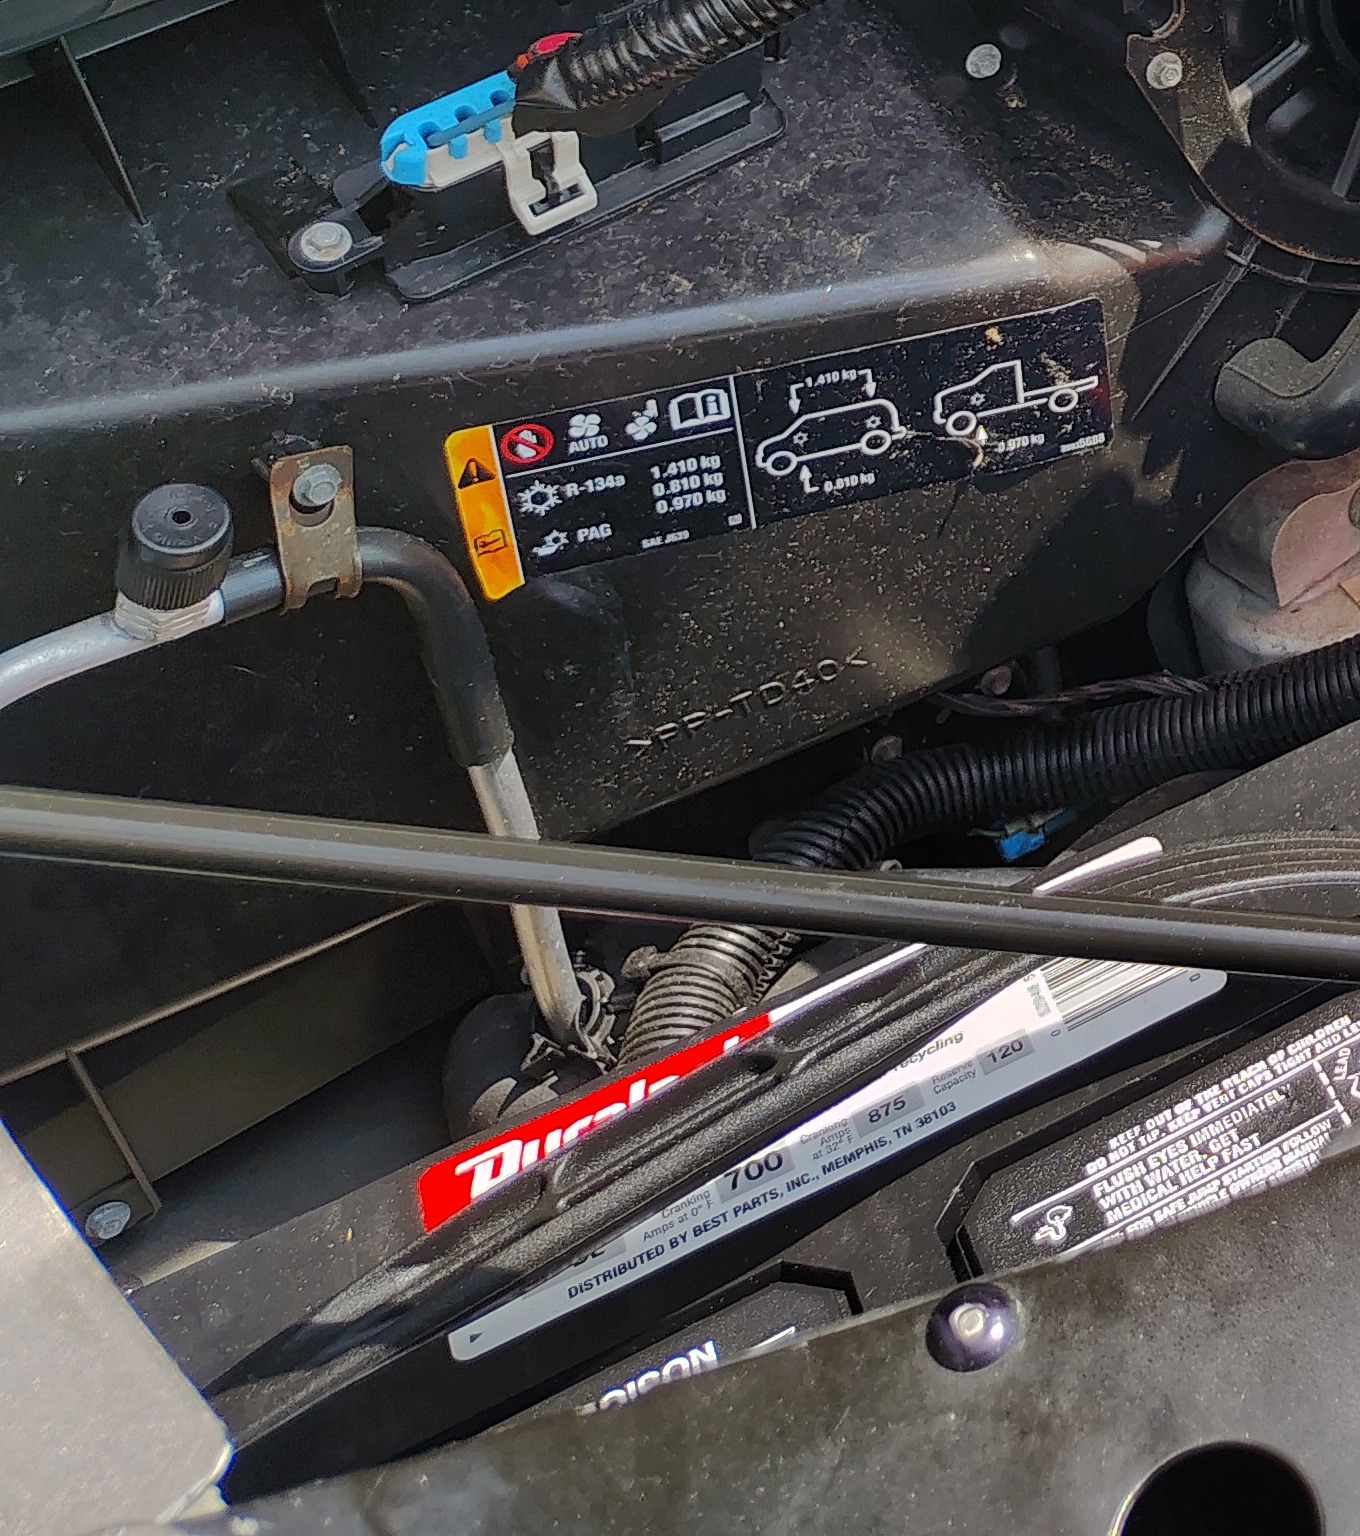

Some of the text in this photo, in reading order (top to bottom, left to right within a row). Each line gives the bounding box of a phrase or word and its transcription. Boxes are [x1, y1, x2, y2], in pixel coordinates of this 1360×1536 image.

[804, 366, 858, 387] 1.410 kg
[568, 435, 609, 455] AUTO
[650, 455, 721, 480] 1.410 kg
[564, 474, 626, 498] R-134a
[652, 471, 724, 497] 0.810 kg
[655, 488, 727, 514] 0.970 kg
[576, 522, 613, 543] PAG
[986, 1039, 1024, 1065] 120
[931, 1061, 974, 1085] Reserve
[933, 1068, 978, 1096] Capacity
[1109, 1124, 1141, 1149] KEEP
[1146, 1109, 1173, 1130] OUT
[1194, 1086, 1221, 1106] THE
[1221, 1061, 1266, 1092] REACH
[1267, 1051, 1287, 1067] OF
[1287, 1015, 1352, 1057] CHILDREN
[867, 1096, 907, 1124] 875
[1085, 1156, 1107, 1178] DO
[1108, 1139, 1140, 1163] NOT
[1141, 1128, 1166, 1147] TIP.
[1168, 1110, 1201, 1133] KEEP
[1202, 1093, 1239, 1118] VENT
[1239, 1072, 1274, 1097] CAPS
[1274, 1051, 1315, 1079] TIGHT
[1315, 1036, 1342, 1056] AND
[800, 1118, 849, 1145] Cranking
[820, 1127, 852, 1147] Amps
[812, 1148, 824, 1161] at
[846, 1133, 855, 1146] F
[724, 1151, 785, 1193] 700
[1092, 1164, 1147, 1199] FLUSH
[1150, 1140, 1188, 1169] EYES
[1099, 1179, 1145, 1210] WITH
[1209, 1128, 1240, 1154] GET
[1105, 1177, 1179, 1225] MEDICAL
[1181, 1156, 1220, 1185] HELP
[1221, 1132, 1262, 1165] FAST
[568, 1244, 665, 1299] DISTRIBUTED
[669, 1231, 689, 1250] BY
[693, 1215, 729, 1237] BEST
[733, 1188, 785, 1218] PARTS,
[786, 1171, 820, 1194] INC.,
[822, 1135, 893, 1176] MEMPHIS,
[893, 1123, 914, 1139] TN
[915, 1101, 957, 1129] 38103
[661, 1189, 712, 1219] Cranking
[642, 1221, 676, 1242] Amps
[678, 1213, 690, 1226] at
[707, 1198, 715, 1211] F
